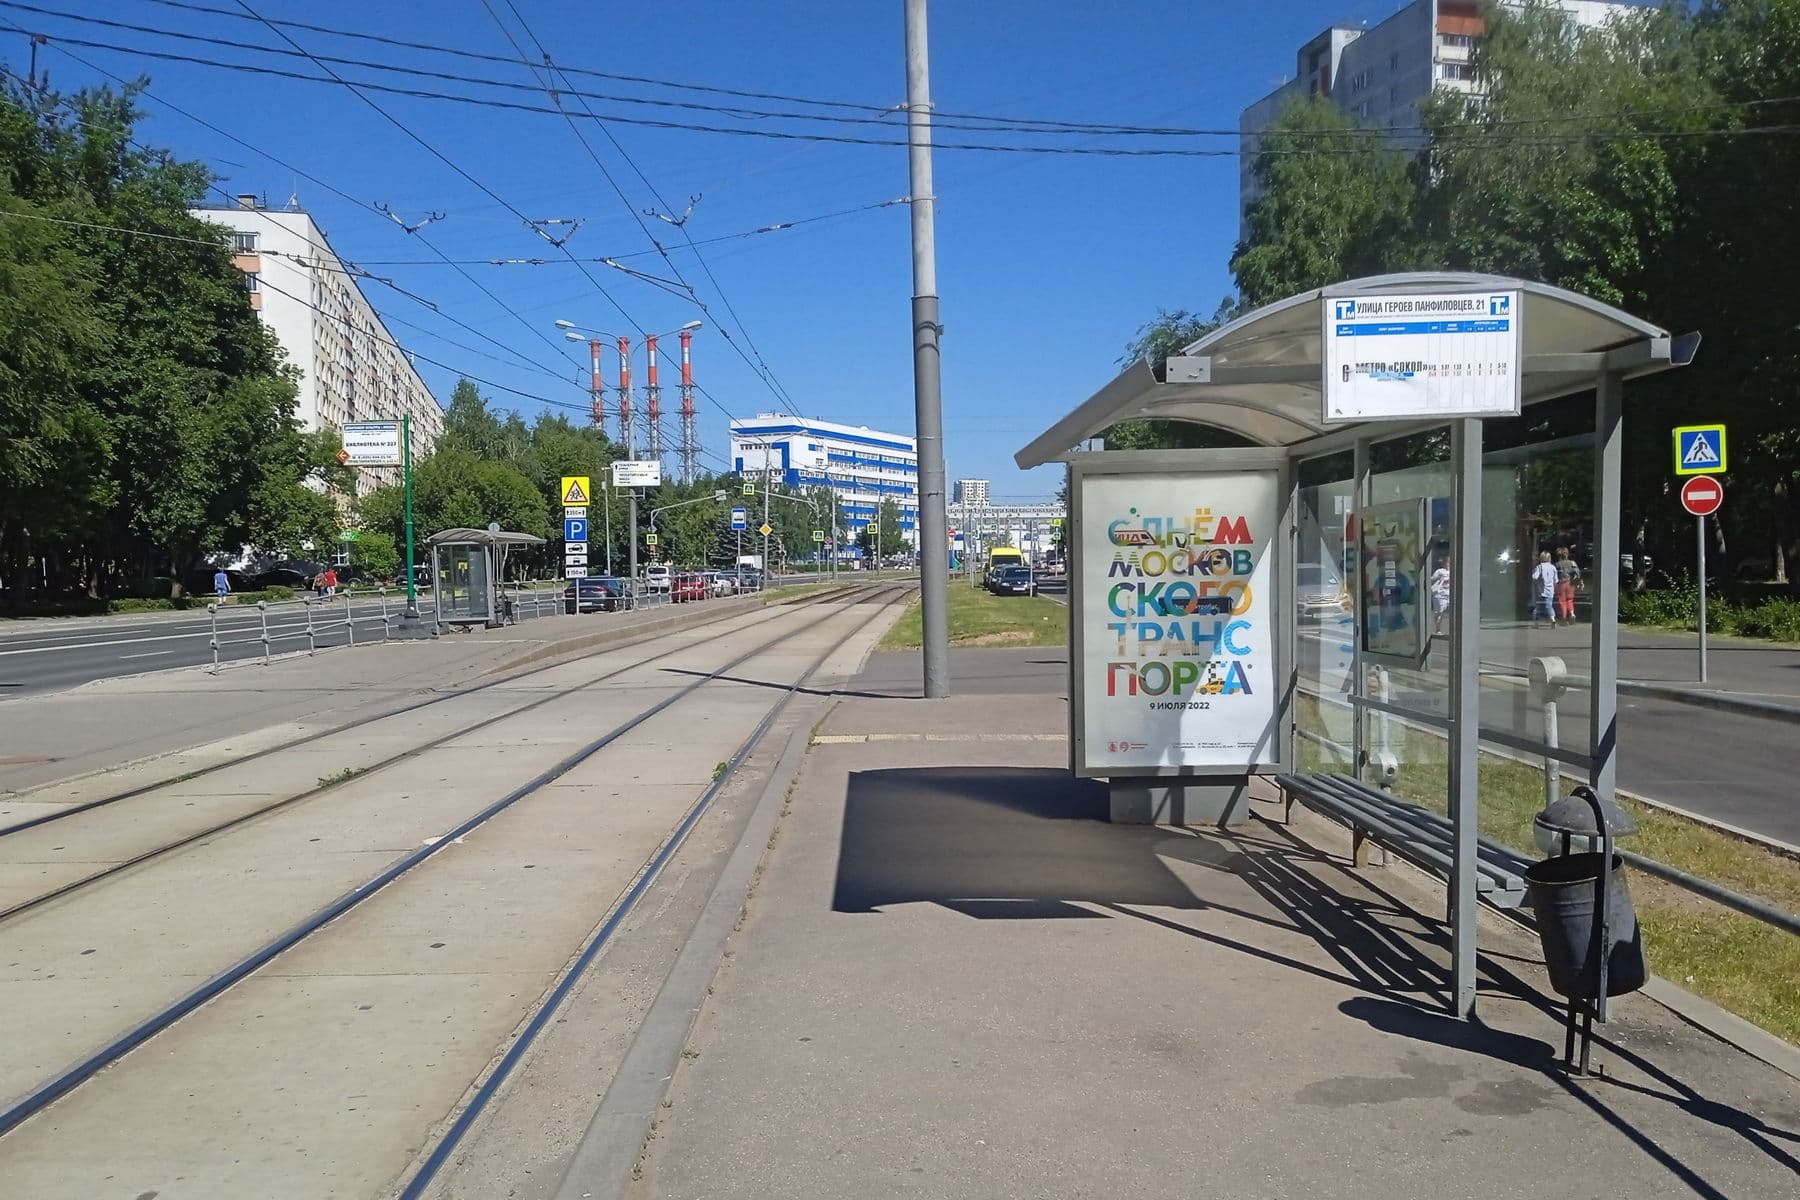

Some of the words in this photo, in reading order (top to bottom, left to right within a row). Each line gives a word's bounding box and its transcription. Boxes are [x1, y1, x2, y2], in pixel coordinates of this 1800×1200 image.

[1357, 302, 1383, 314] УЛИЦА
[1385, 301, 1413, 313] ГЕРОЕВ
[1476, 299, 1485, 310] 21
[1388, 361, 1428, 373] «СОКОЛ»
[571, 522, 583, 539] P
[1142, 508, 1253, 548] ДНЁМ
[1108, 547, 1253, 578] МОСКОВ
[1107, 580, 1253, 618] СКОГО
[1107, 620, 1253, 656] ТРАНС
[1107, 660, 1253, 697] ПОРТА
[1157, 702, 1187, 710] ИЮЛЯ
[1188, 702, 1210, 710] 2022
